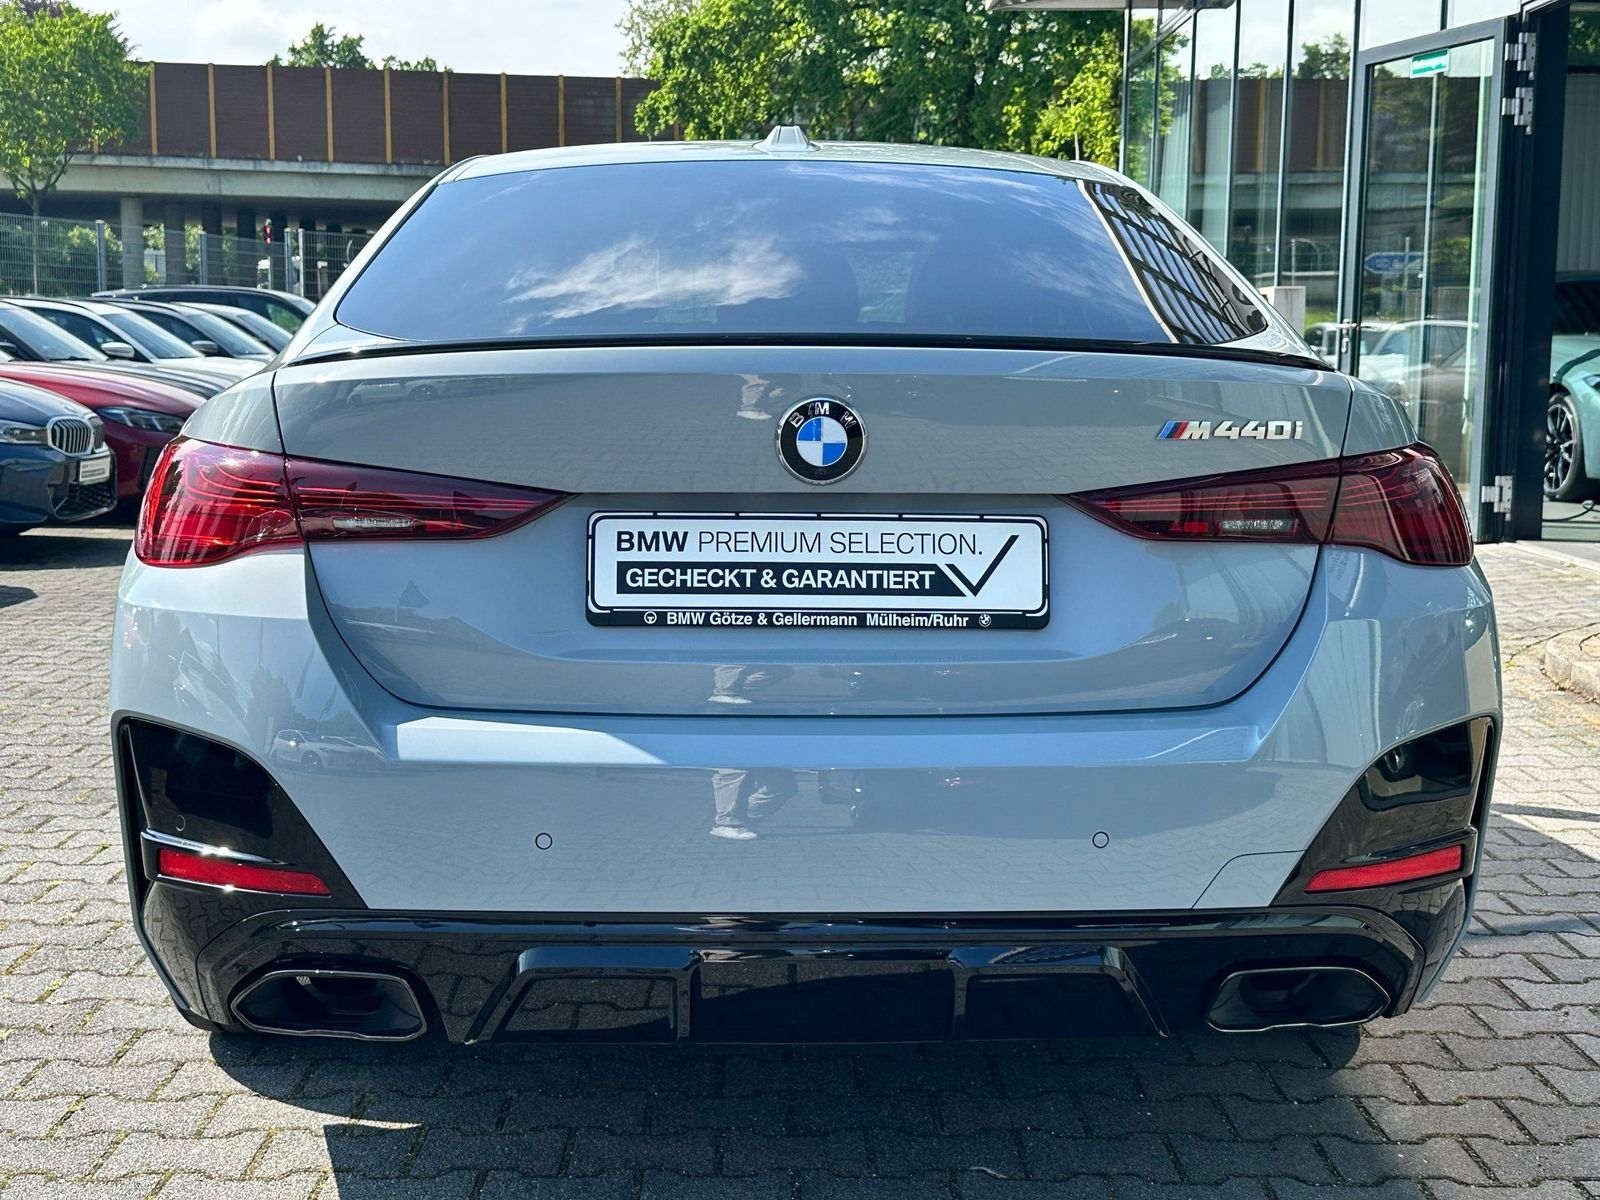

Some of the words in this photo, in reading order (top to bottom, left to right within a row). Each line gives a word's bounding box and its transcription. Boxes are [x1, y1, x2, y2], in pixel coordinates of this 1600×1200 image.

[788, 402, 856, 428] BMW
[1179, 420, 1304, 440] M440i
[616, 530, 689, 552] BMW
[699, 531, 822, 553] PREMIUM
[830, 532, 983, 555] SELECTION.
[625, 568, 757, 588] GECHECKT
[760, 569, 777, 588] &
[782, 569, 936, 590] GARANTIERT
[666, 612, 705, 625] BMW
[709, 611, 753, 626] Götze
[757, 613, 768, 626] &
[772, 612, 857, 627] Gellermann
[866, 613, 969, 627] Mülheim/Ruhr
